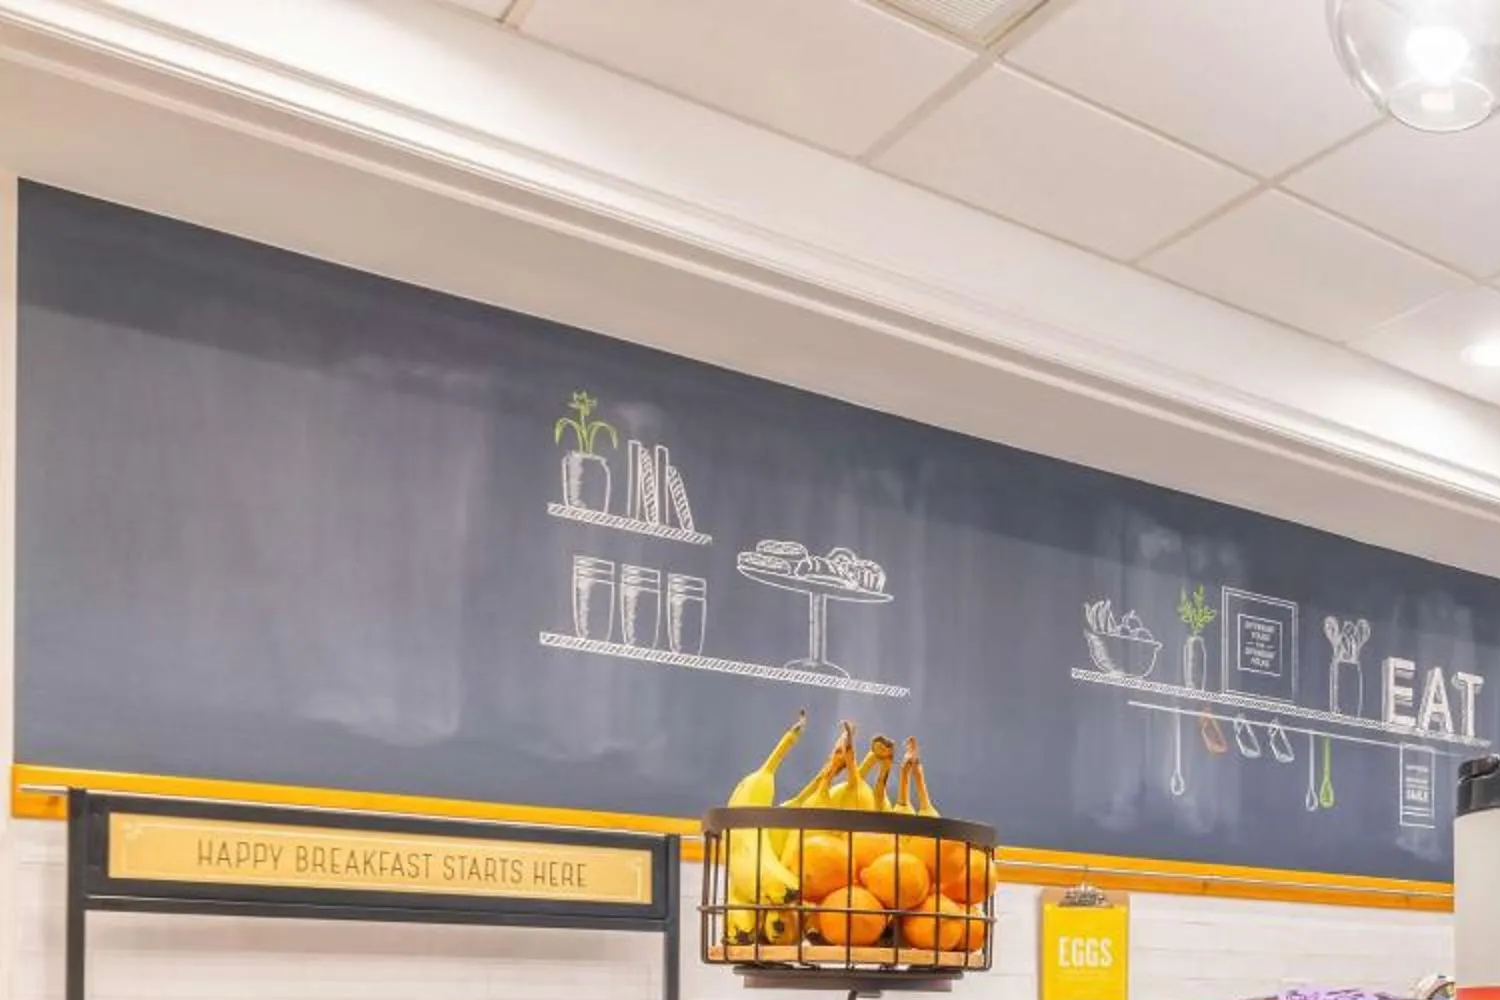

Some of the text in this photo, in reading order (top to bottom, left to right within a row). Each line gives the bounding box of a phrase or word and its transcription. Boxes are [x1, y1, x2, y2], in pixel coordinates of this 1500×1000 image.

[1382, 656, 1484, 738] EAT
[197, 839, 588, 887] HAPPY BREAKFAST STARTS HERE
[1058, 936, 1114, 968] EGGS
